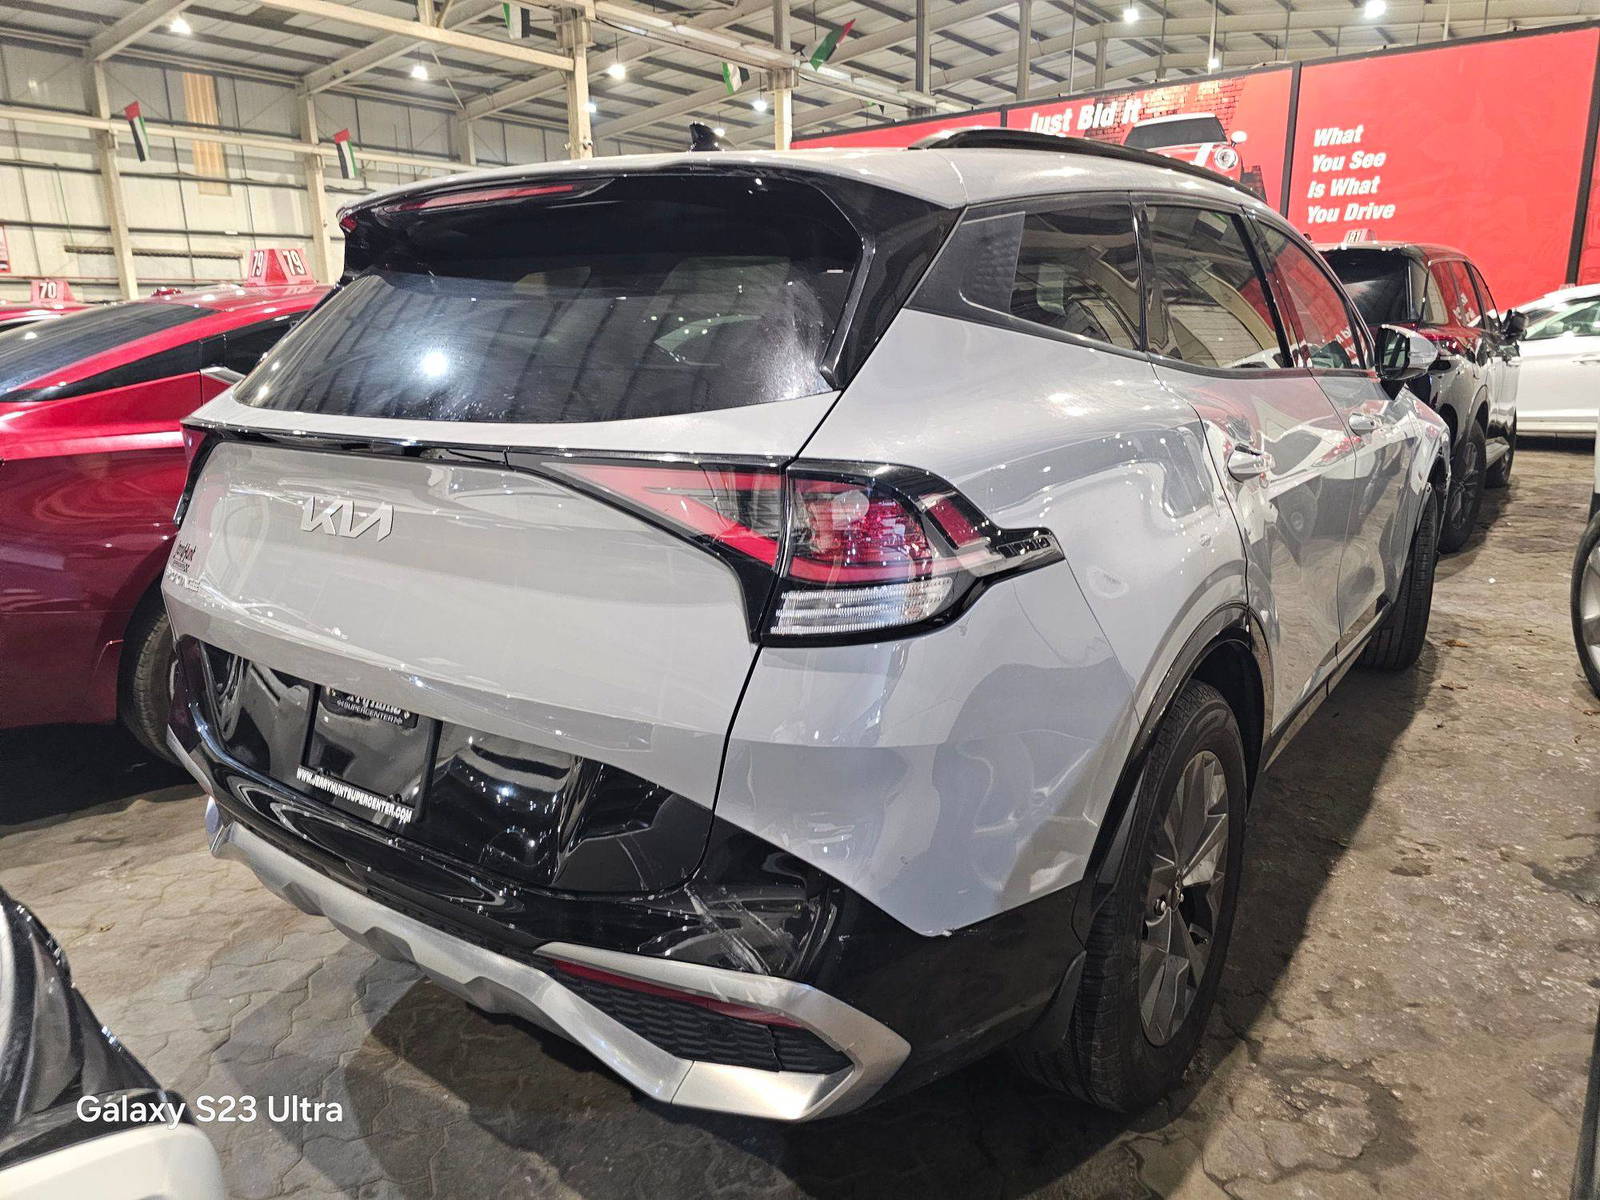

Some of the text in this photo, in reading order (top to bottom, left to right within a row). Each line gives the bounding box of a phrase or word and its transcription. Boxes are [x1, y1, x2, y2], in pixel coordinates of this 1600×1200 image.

[1026, 108, 1073, 134] Just
[1314, 124, 1364, 147] What
[1312, 150, 1386, 173] You See
[1307, 175, 1380, 198] Is What
[1307, 202, 1396, 224] You Drive
[252, 250, 264, 278] 79
[282, 249, 307, 276] 79
[39, 281, 57, 299] 70
[301, 495, 394, 542] KIA
